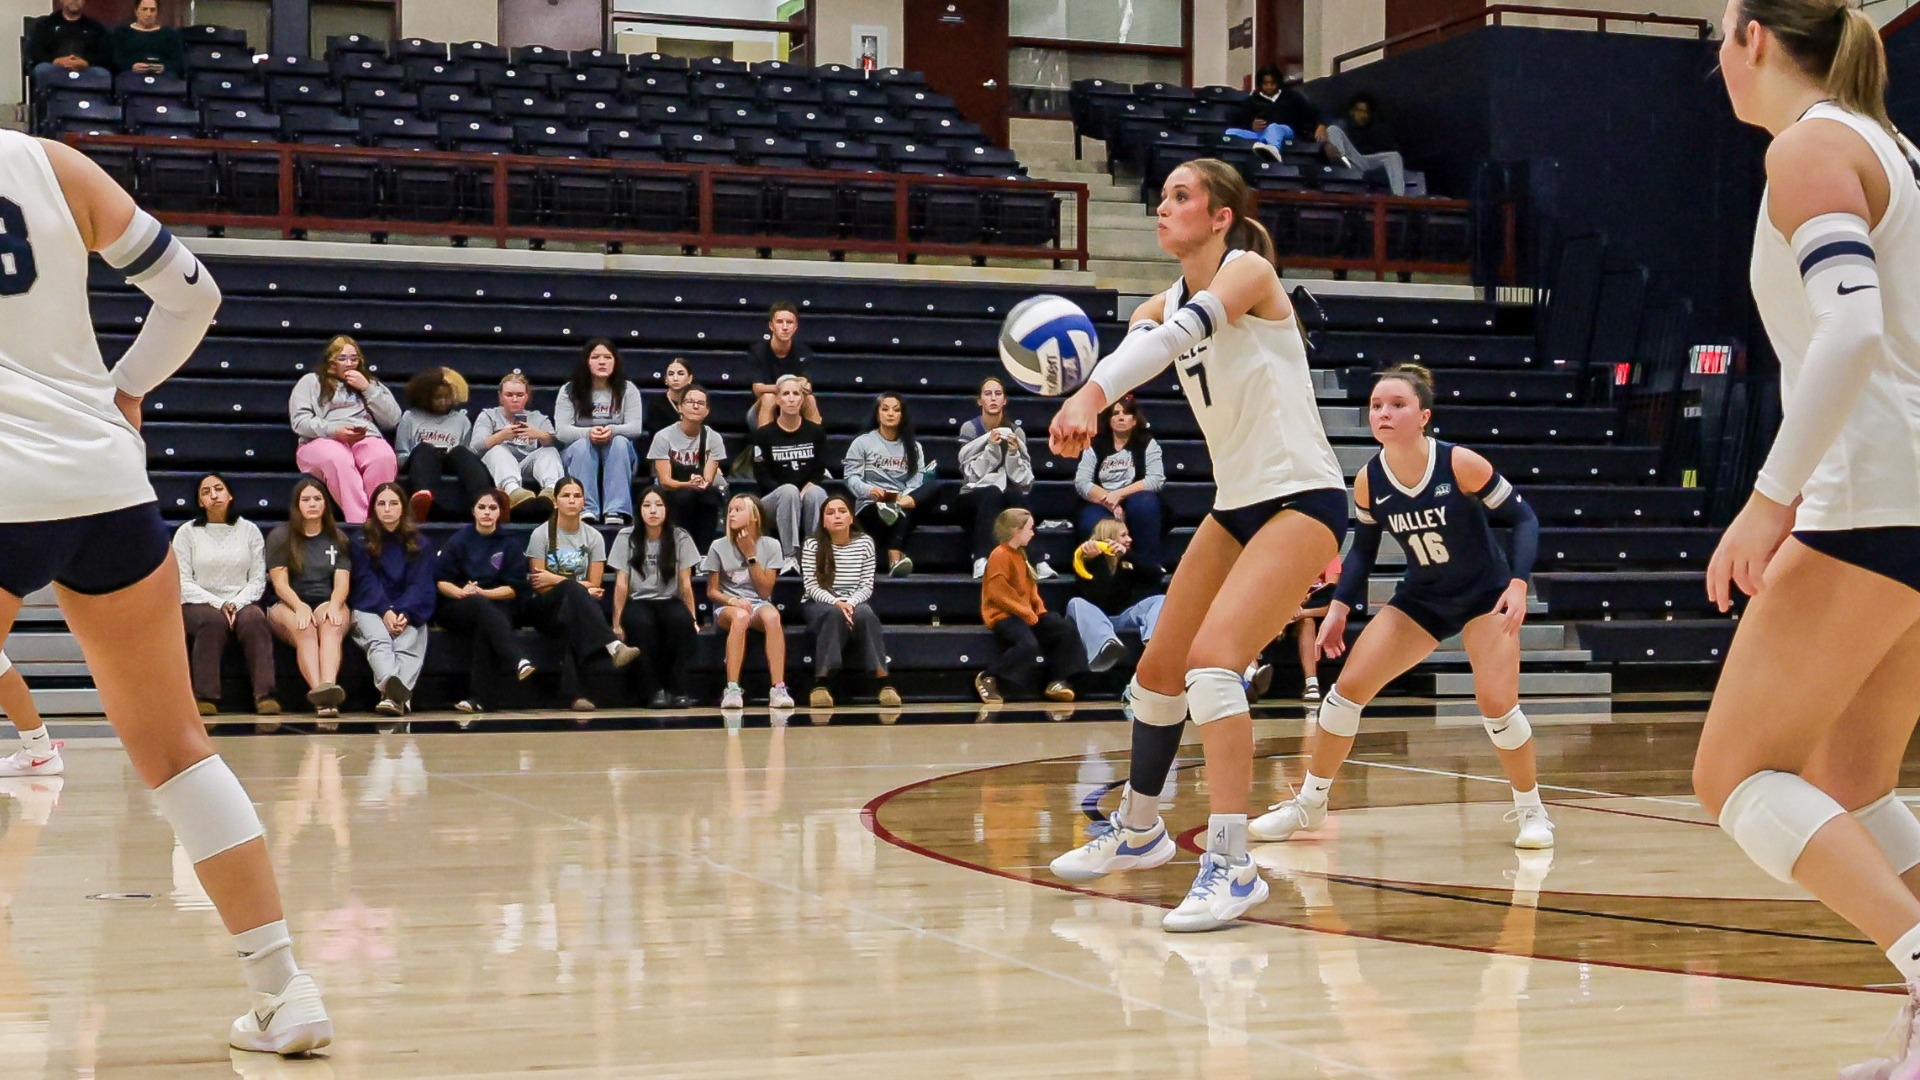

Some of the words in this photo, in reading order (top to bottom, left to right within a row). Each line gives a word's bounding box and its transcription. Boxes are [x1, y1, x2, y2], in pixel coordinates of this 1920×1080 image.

[1185, 361, 1212, 408] 7
[772, 448, 815, 462] VOLLEYBALL
[1388, 505, 1447, 533] VALLEY
[1407, 531, 1450, 566] 16
